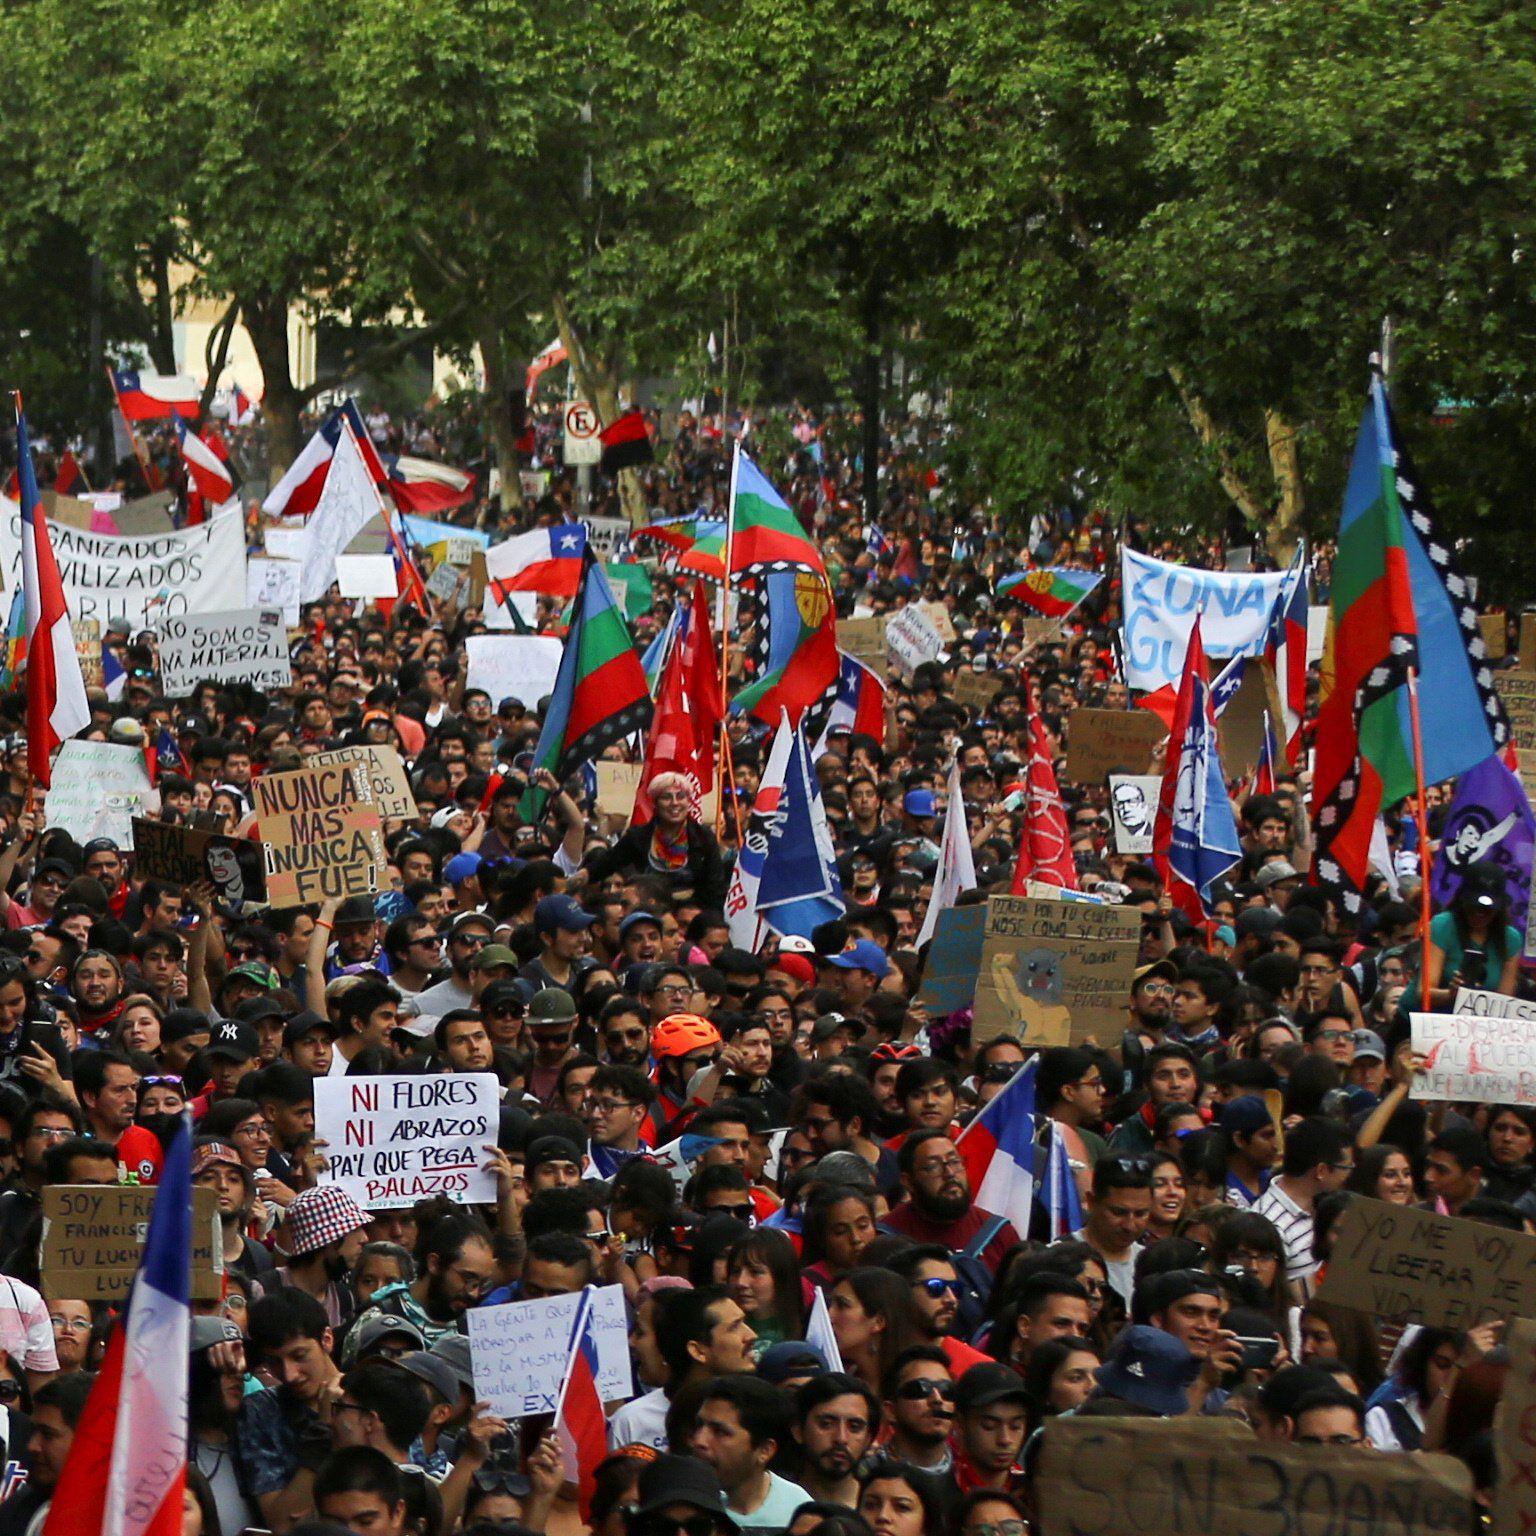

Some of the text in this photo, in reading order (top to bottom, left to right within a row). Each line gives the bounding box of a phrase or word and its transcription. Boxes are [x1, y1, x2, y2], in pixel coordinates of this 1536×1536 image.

[10, 514, 221, 558] OGANIZADOS Y
[12, 550, 203, 589] VILIZADOS
[1128, 555, 1267, 618] ZONA
[160, 619, 186, 643] NO
[192, 625, 272, 649] SOMOS
[189, 643, 287, 668] MATERIAL
[351, 1079, 478, 1113] NI FLORES
[345, 1115, 488, 1148] NI ABRAZOS
[328, 1146, 478, 1181] PA'L QUE PEGA
[365, 1172, 470, 1201] BALAZOS
[59, 1193, 104, 1222] SOY
[64, 1222, 149, 1240] FRANCISC
[1410, 1219, 1453, 1251] ME
[59, 1248, 86, 1267] TU
[93, 1249, 139, 1266] LUCH
[494, 1304, 536, 1328] GENTE
